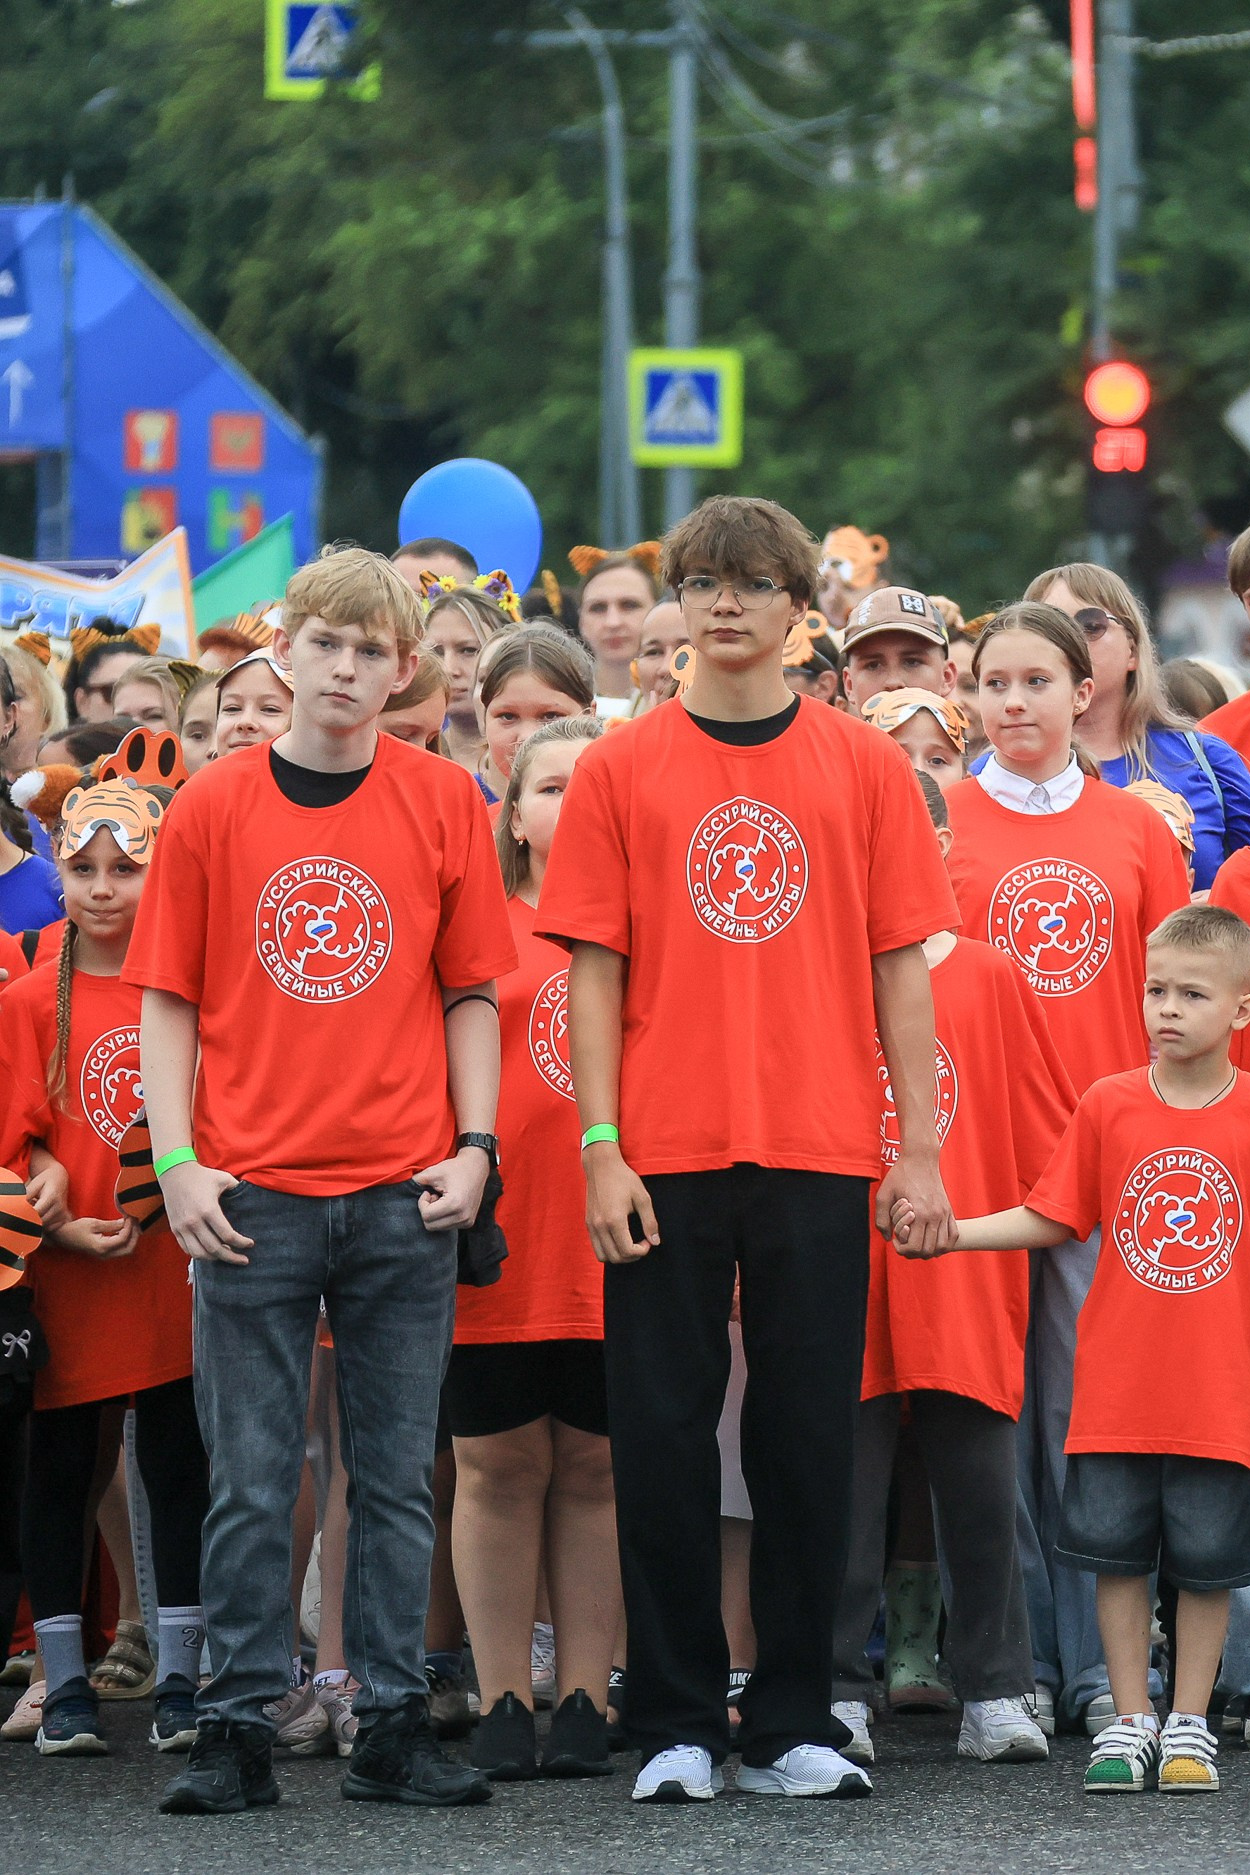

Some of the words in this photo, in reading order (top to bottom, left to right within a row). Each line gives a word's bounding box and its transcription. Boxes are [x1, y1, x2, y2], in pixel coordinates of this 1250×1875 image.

[696, 802, 798, 853] УССУРИЙСКИЕ
[263, 861, 379, 910] УССУРИЙСКИЕ
[762, 883, 802, 932] ИГРЫ
[997, 862, 1107, 906] УССУРИЙСКИЕ
[261, 940, 346, 998] СЕМЕЙНЫЕ
[349, 940, 387, 988] ИГРЫ
[1075, 935, 1109, 983] ИГРЫ
[1125, 1152, 1234, 1205] УССУРИЙСКИЕ
[1119, 1228, 1198, 1288] СЕМЕЙНЫЕ
